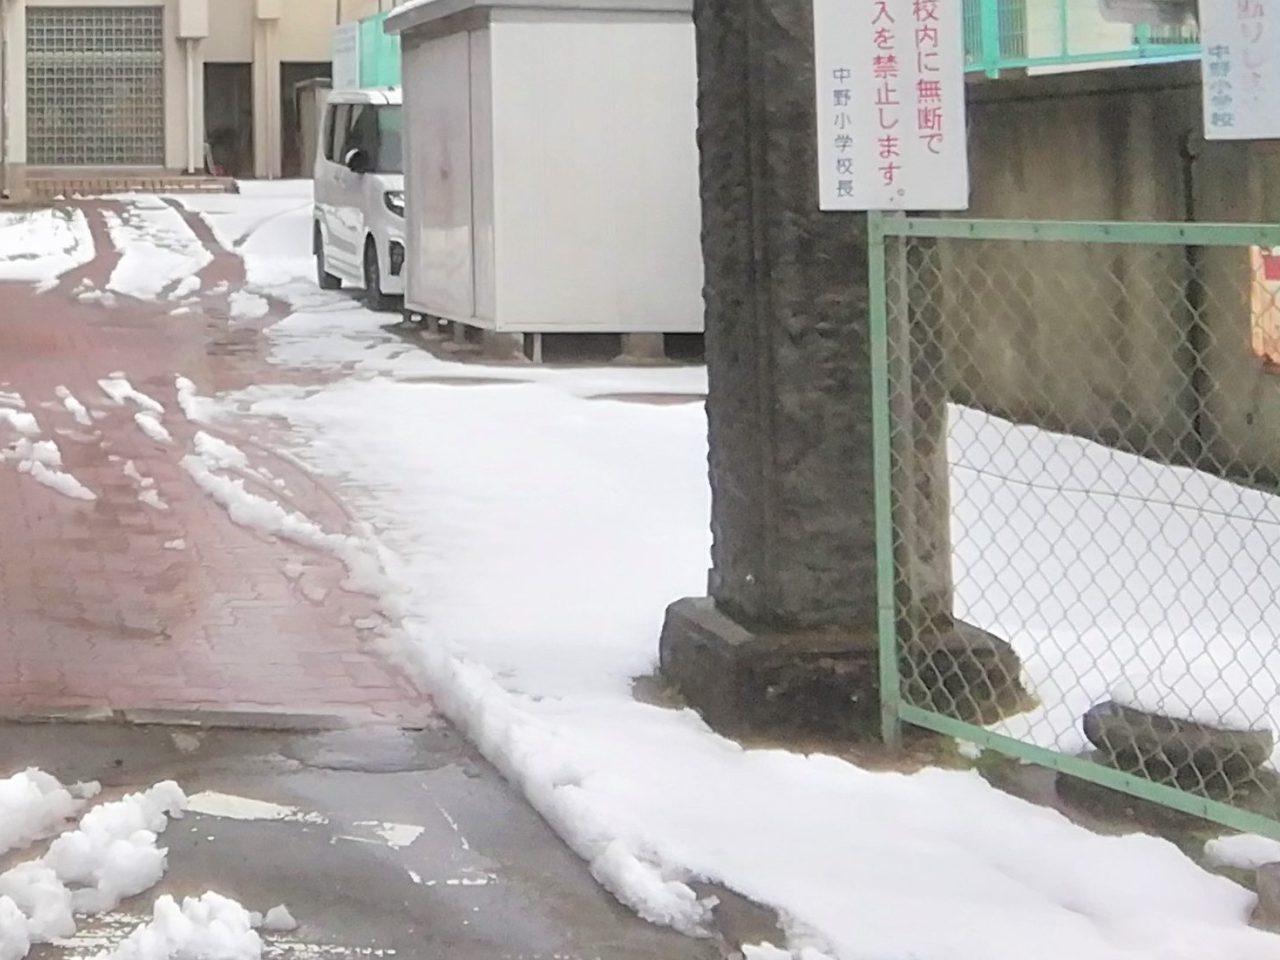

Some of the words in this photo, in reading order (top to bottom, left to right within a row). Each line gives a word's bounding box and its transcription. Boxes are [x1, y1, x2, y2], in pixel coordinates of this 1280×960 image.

[833, 67, 854, 197] 中野小学校長
